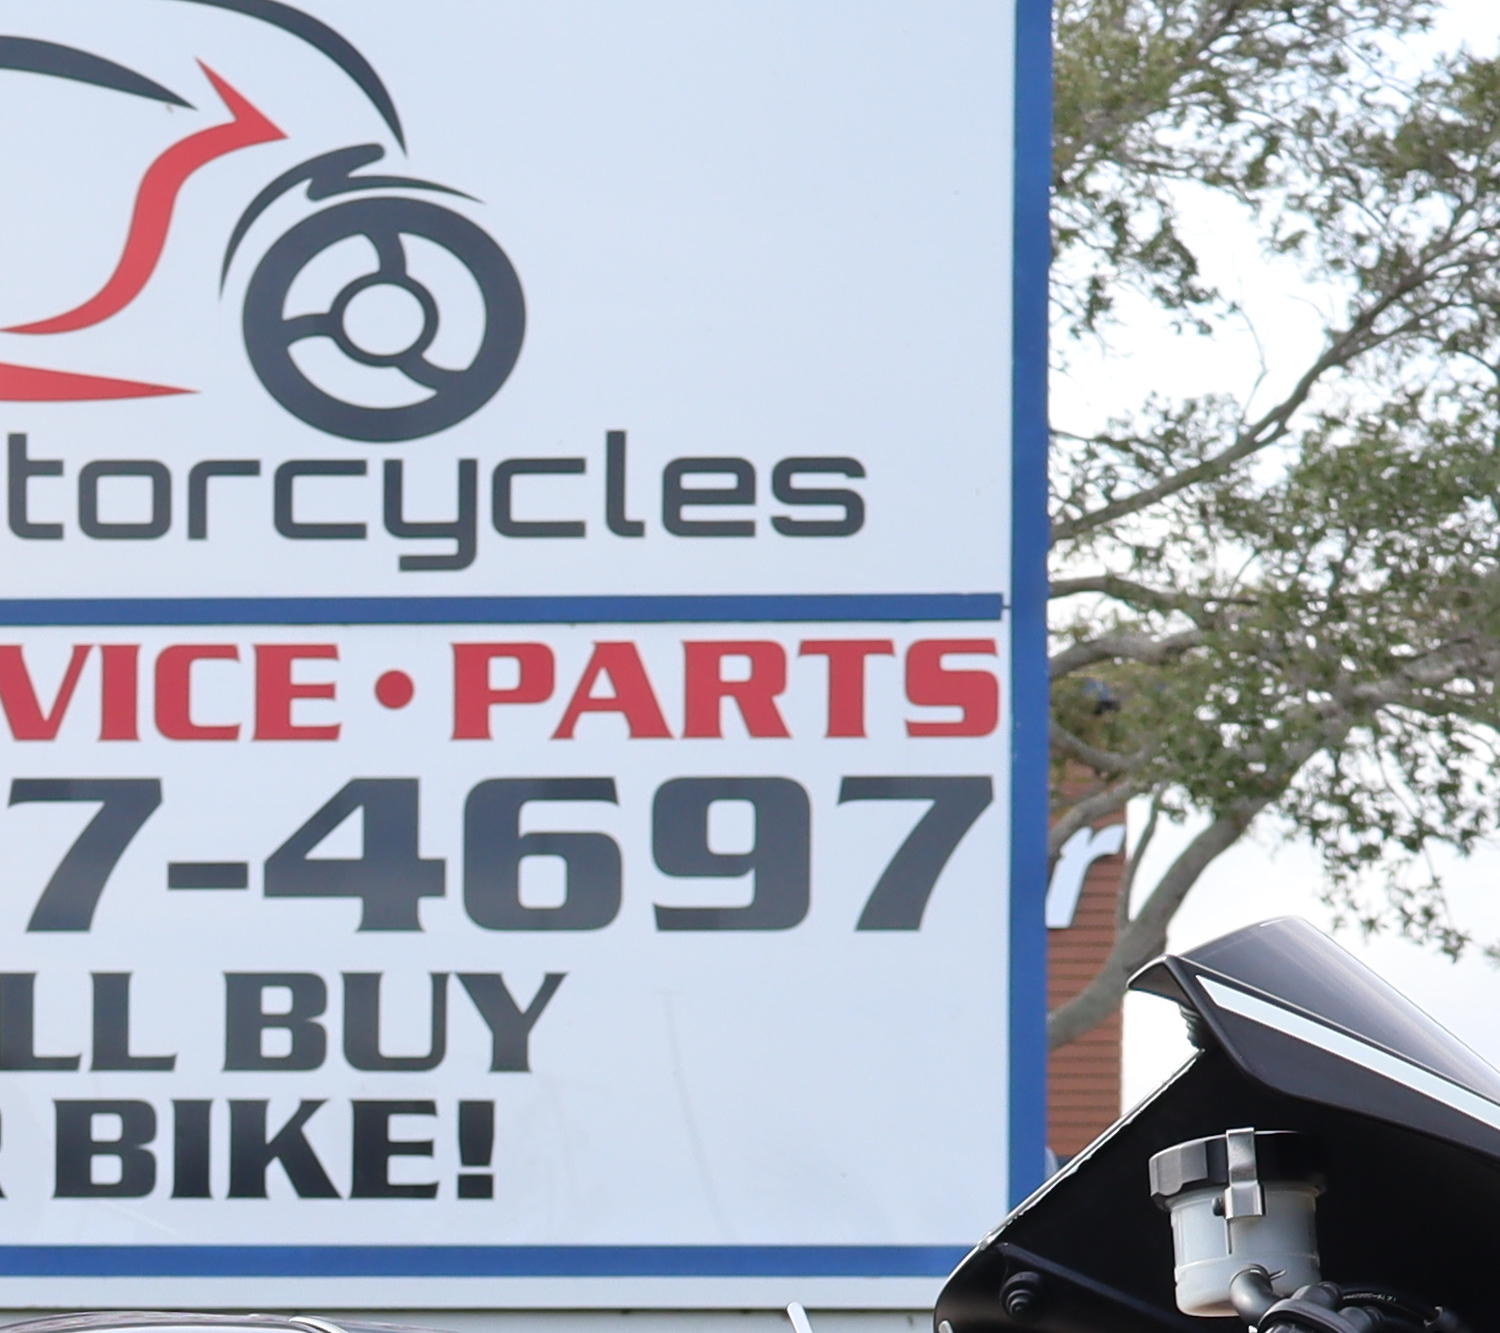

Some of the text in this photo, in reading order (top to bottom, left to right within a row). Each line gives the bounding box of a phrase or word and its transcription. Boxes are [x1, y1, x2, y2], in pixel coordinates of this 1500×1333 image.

[453, 638, 1000, 741] PARTS
[222, 972, 569, 1075] BUY
[52, 1099, 497, 1202] BIKE!
